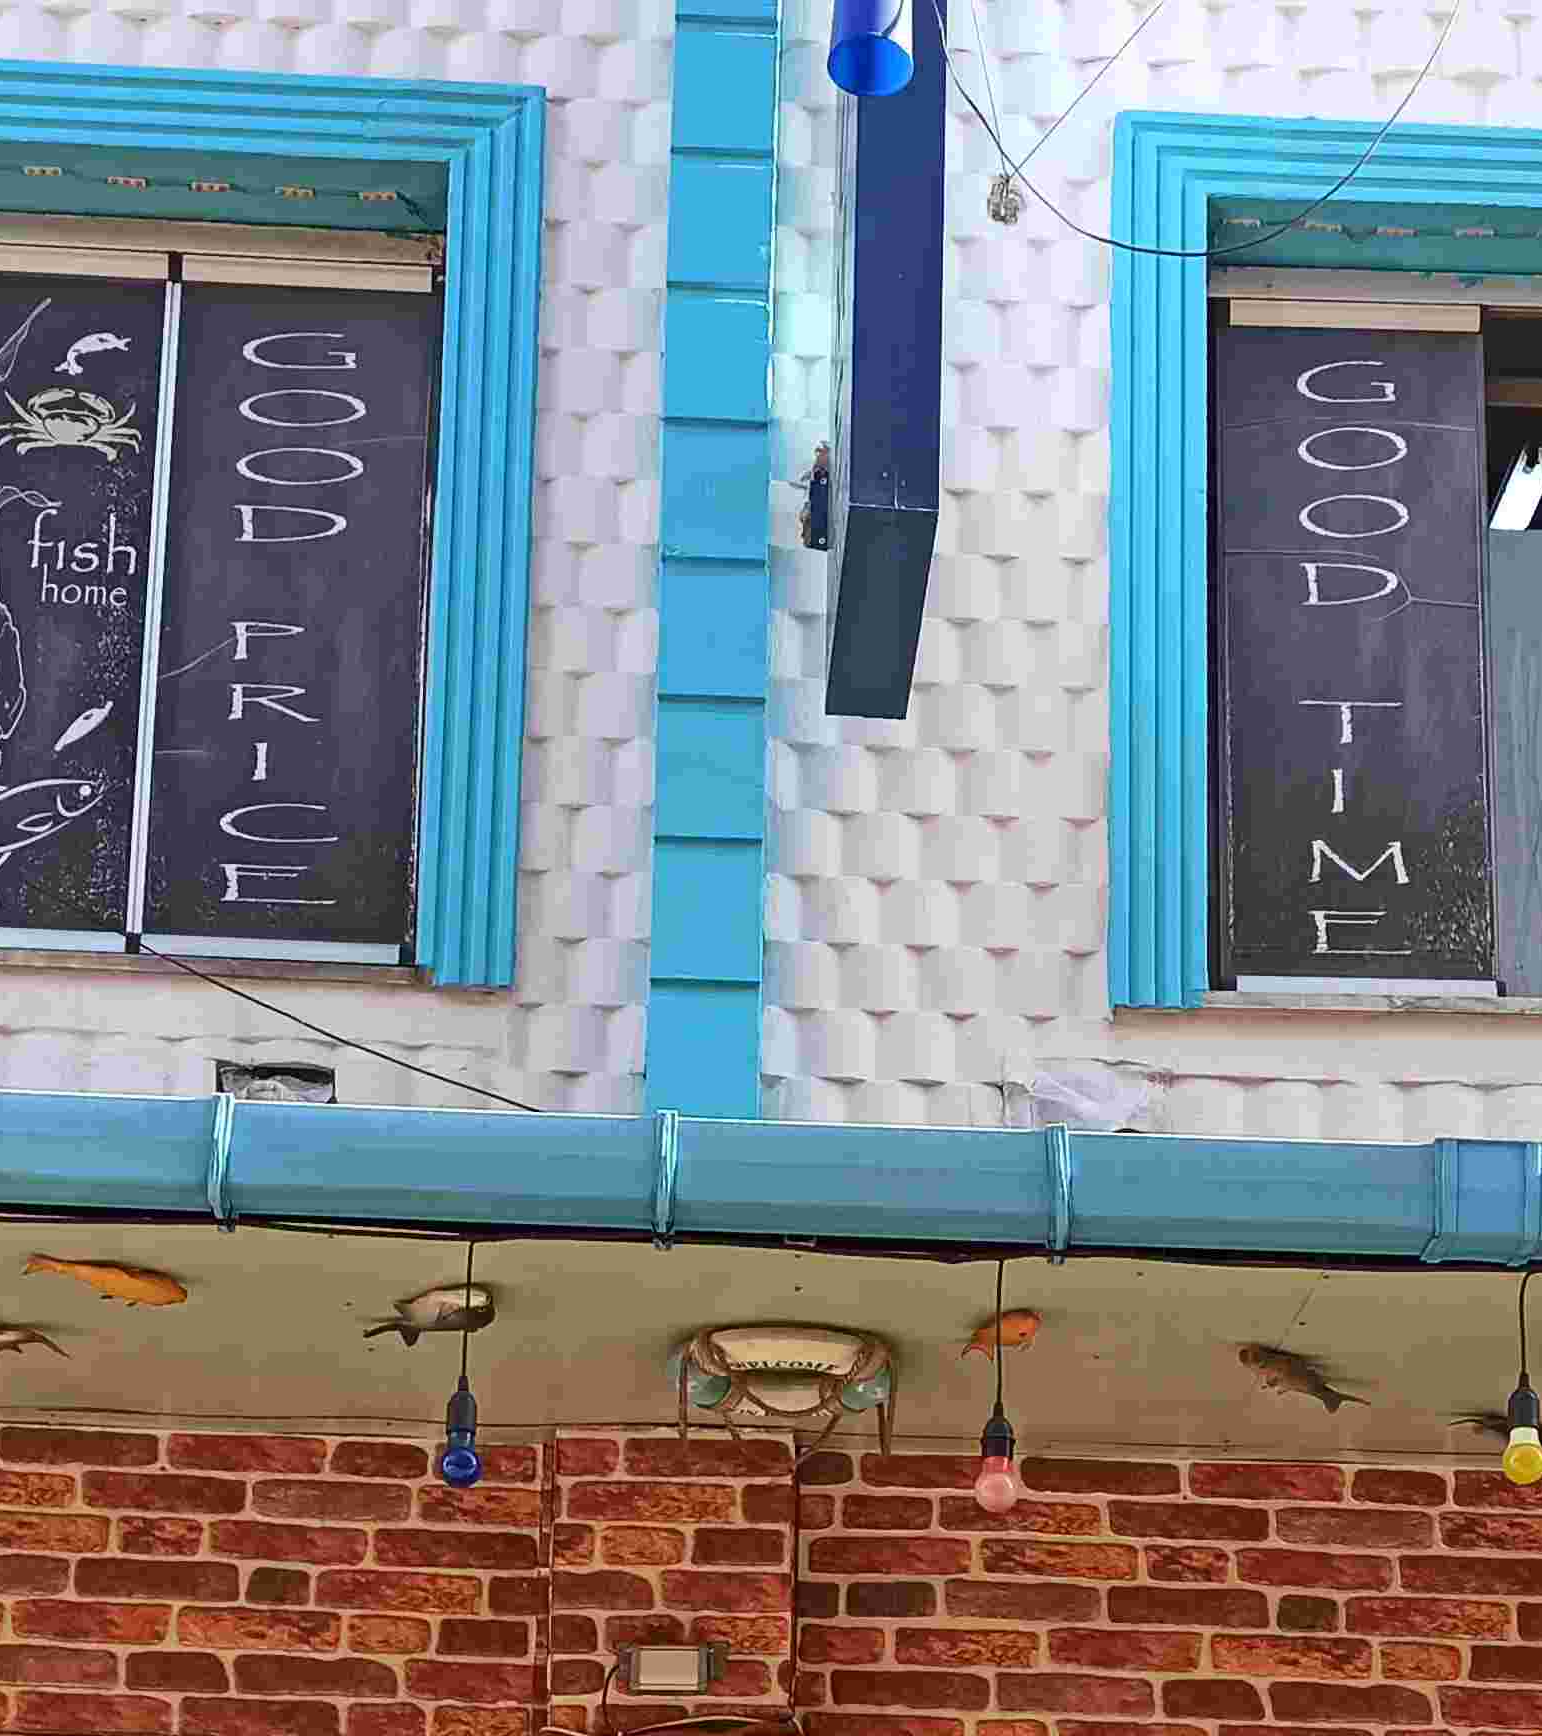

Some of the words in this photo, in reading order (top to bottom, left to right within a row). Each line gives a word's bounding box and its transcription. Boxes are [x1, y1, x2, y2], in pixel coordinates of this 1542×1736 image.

[28, 508, 139, 576] fish
[235, 332, 367, 543] GOOD
[1296, 360, 1410, 606] GOOD
[41, 565, 128, 608] home
[218, 622, 340, 905] PRICE
[1298, 700, 1412, 955] TIME
